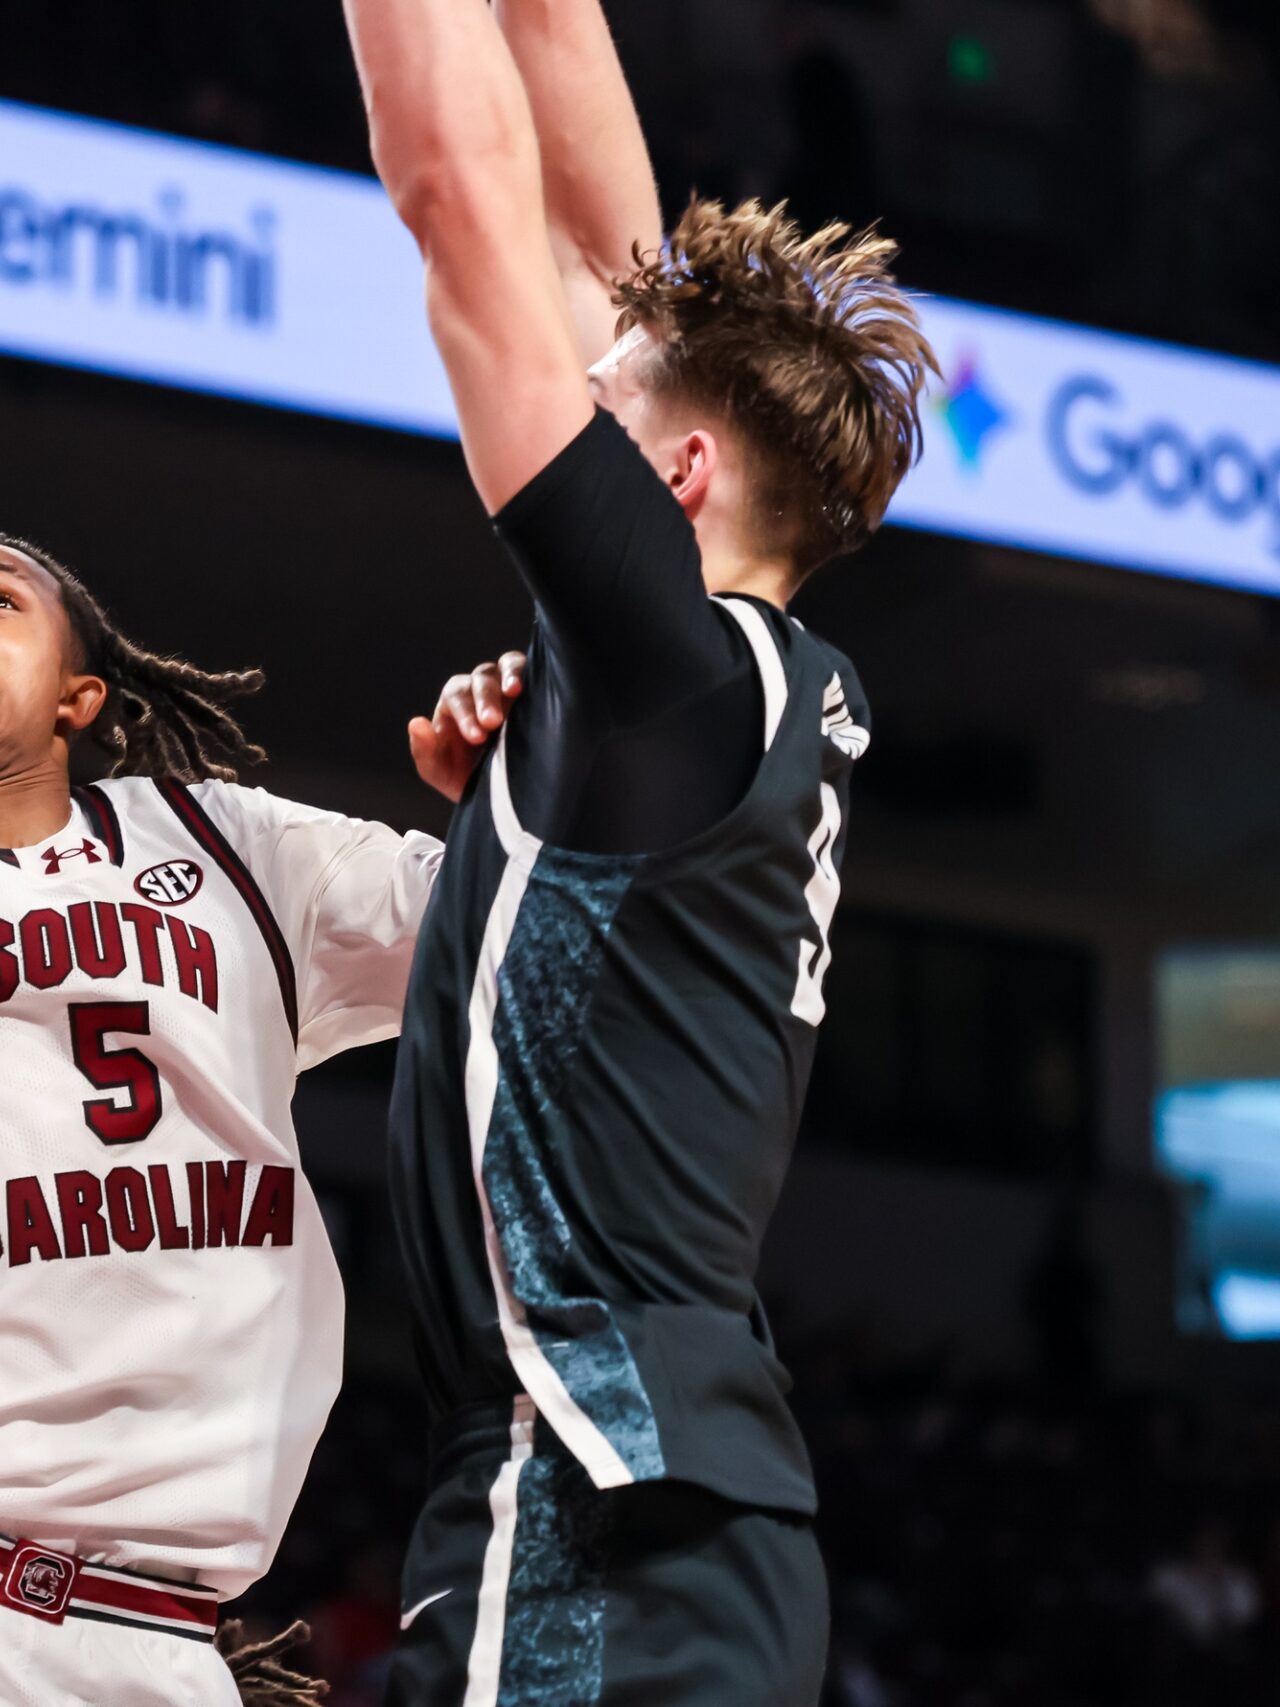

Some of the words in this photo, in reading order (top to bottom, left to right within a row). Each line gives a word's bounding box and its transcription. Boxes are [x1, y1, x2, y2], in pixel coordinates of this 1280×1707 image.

[1044, 371, 1280, 558] Goo
[139, 862, 198, 903] SEC
[67, 1000, 163, 1147] 5
